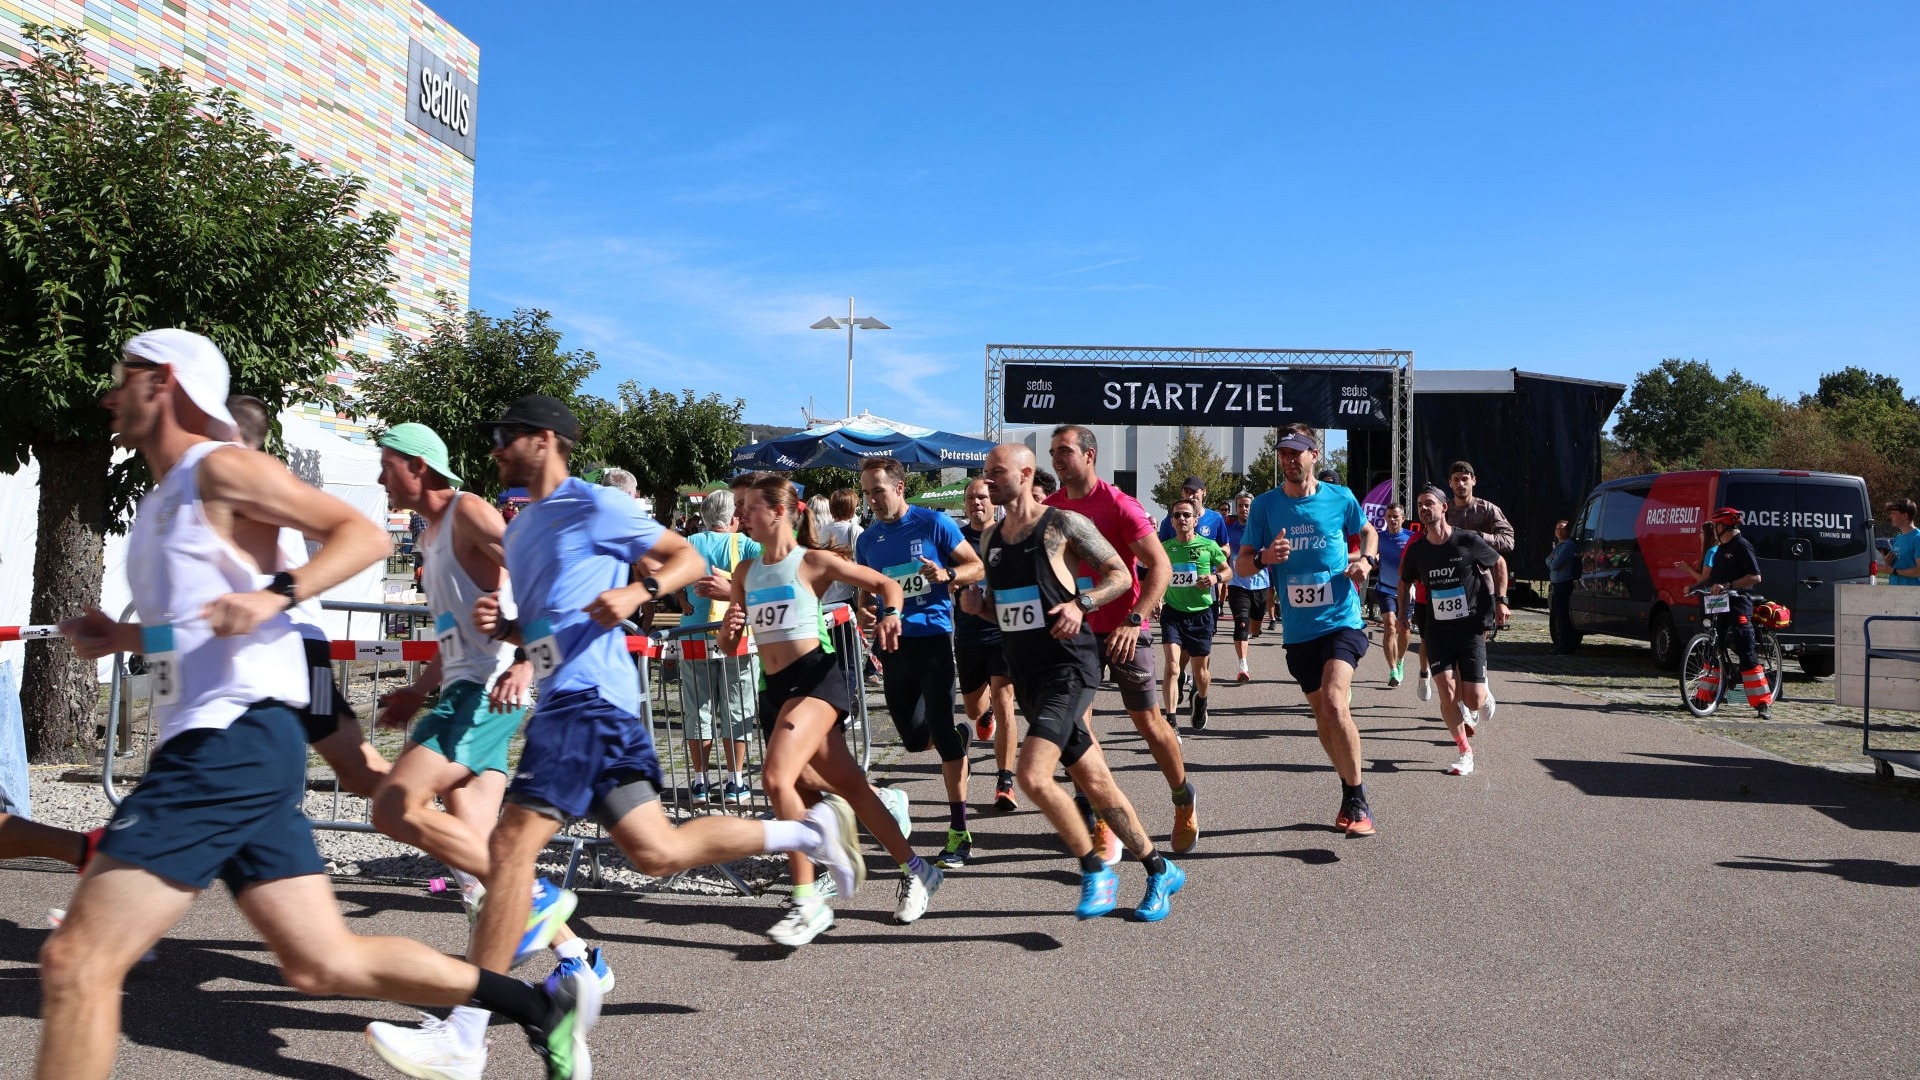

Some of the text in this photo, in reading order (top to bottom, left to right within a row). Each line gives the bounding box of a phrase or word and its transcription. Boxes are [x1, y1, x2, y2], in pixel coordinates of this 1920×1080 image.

[420, 66, 470, 136] sedus
[1026, 378, 1053, 391] sedus
[1341, 384, 1368, 397] sedus
[1023, 392, 1056, 409] run
[1103, 380, 1293, 414] START/ZIEL
[1338, 398, 1371, 415] run
[1646, 506, 1701, 525] RACE RESULT
[1739, 510, 1853, 530] RACE RESULT
[1290, 523, 1315, 536] sedus
[1819, 531, 1852, 540] TIMING BW
[1289, 535, 1327, 551] un'26
[896, 575, 924, 594] 49
[1172, 573, 1194, 585] 234
[1294, 586, 1326, 604] 331
[1437, 598, 1463, 612] 438
[755, 604, 789, 627] 497
[1002, 604, 1035, 627] 476
